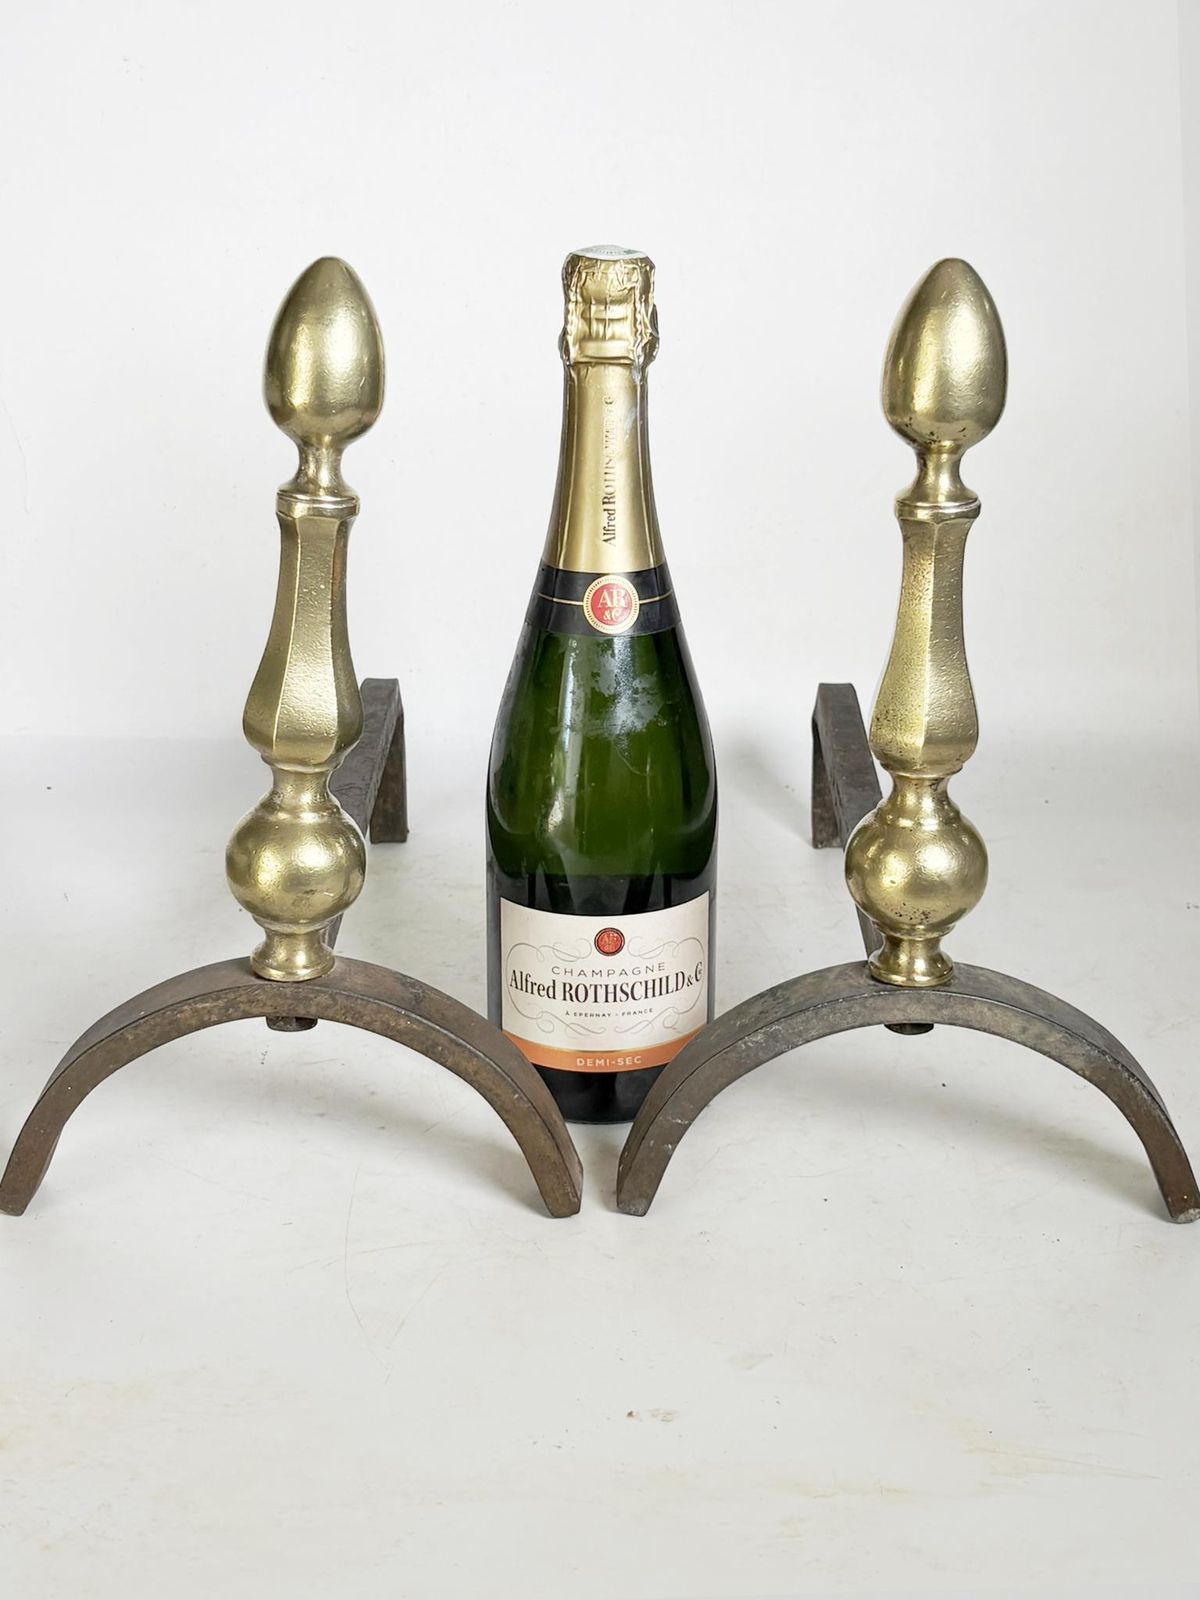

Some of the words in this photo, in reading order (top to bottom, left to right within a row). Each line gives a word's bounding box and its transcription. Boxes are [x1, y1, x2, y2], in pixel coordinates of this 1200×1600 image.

[602, 508, 616, 547] Alfred
[551, 962, 666, 978] CHAMPAGNE
[509, 969, 556, 1000] Alfred
[621, 1008, 654, 1017] FRANCE
[576, 1055, 642, 1067] DEMI-SEC
